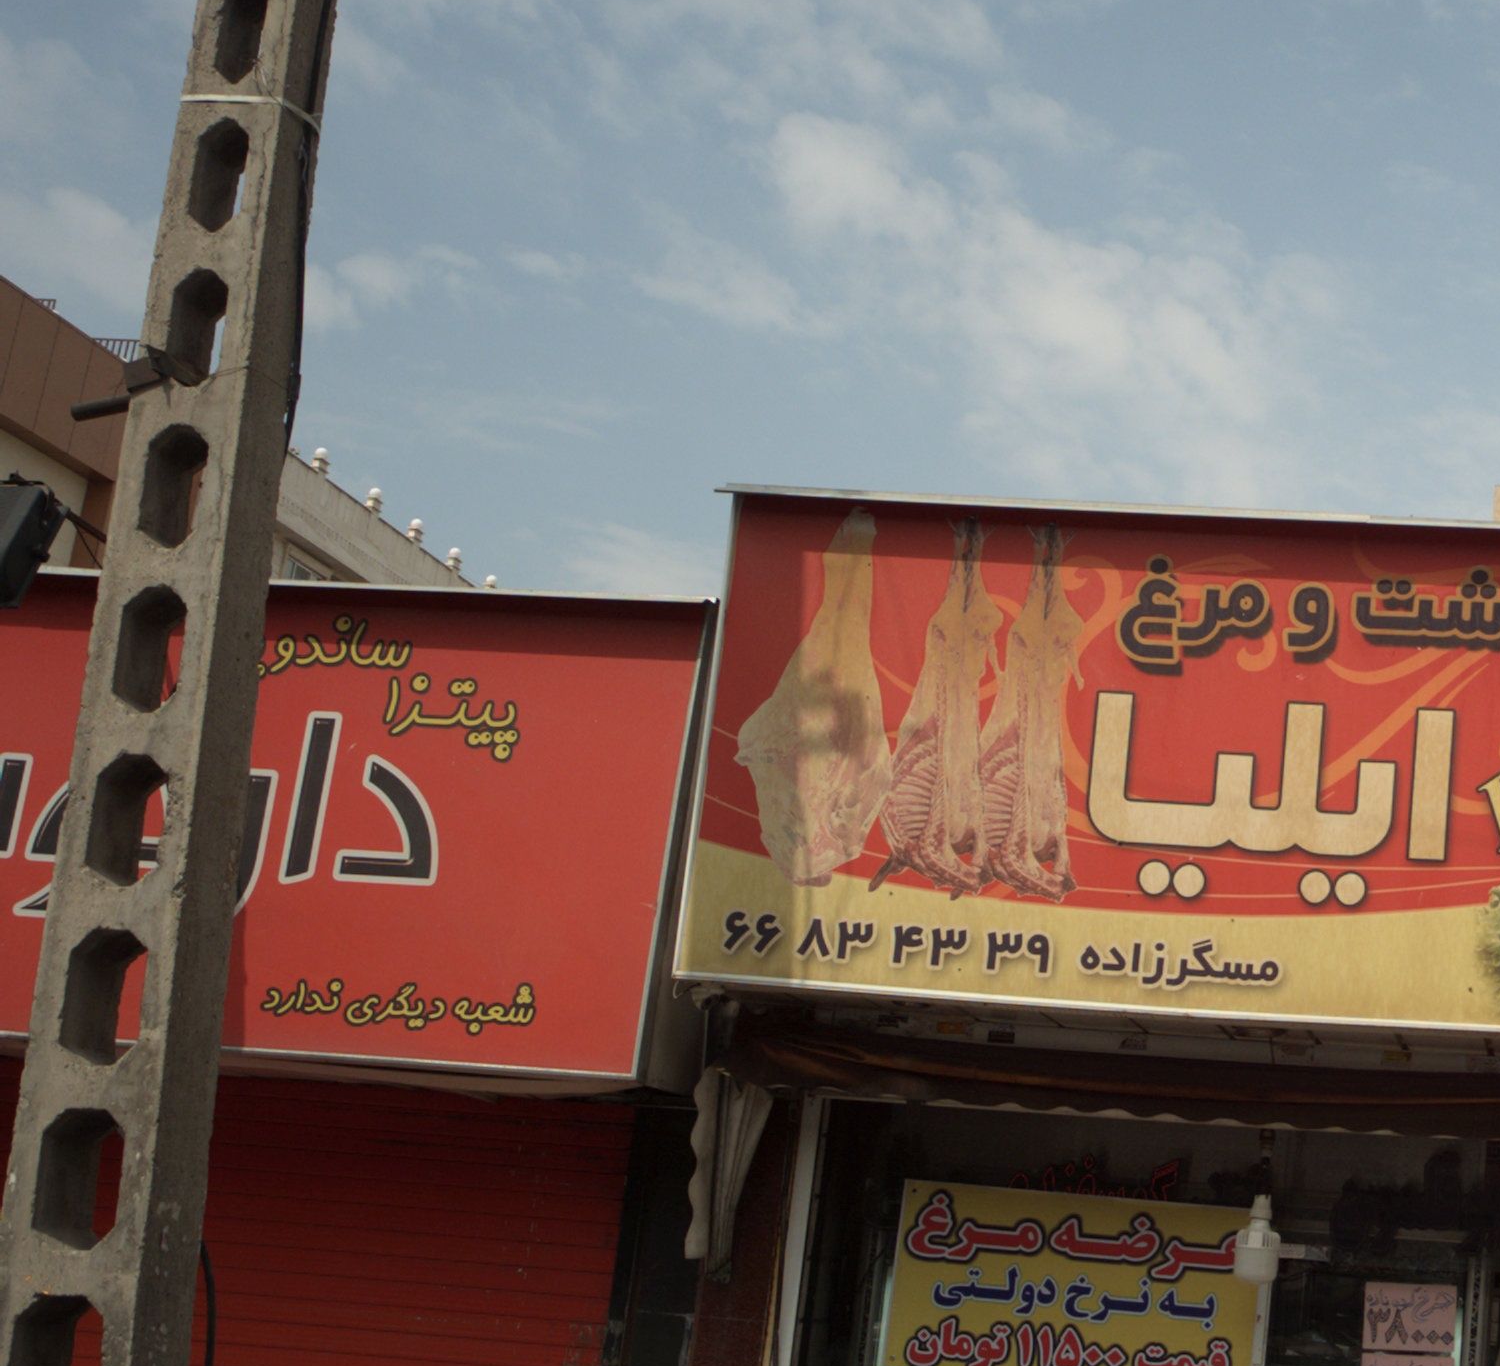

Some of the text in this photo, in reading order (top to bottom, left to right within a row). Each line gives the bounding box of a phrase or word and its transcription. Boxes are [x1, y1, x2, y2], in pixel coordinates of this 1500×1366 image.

[1117, 554, 1271, 669] مرغ
[1283, 580, 1336, 657] و
[383, 674, 520, 761] پیتزا
[1087, 690, 1456, 907] ایلیا
[1079, 937, 1282, 987] مسگرزاده
[261, 977, 536, 1035] شعبه دیگری ندارد
[908, 1191, 1043, 1259] مرغ
[932, 1265, 1218, 1328] به نرخ دولتی
[1367, 1307, 1454, 1345] ۳۸۰۰۰
